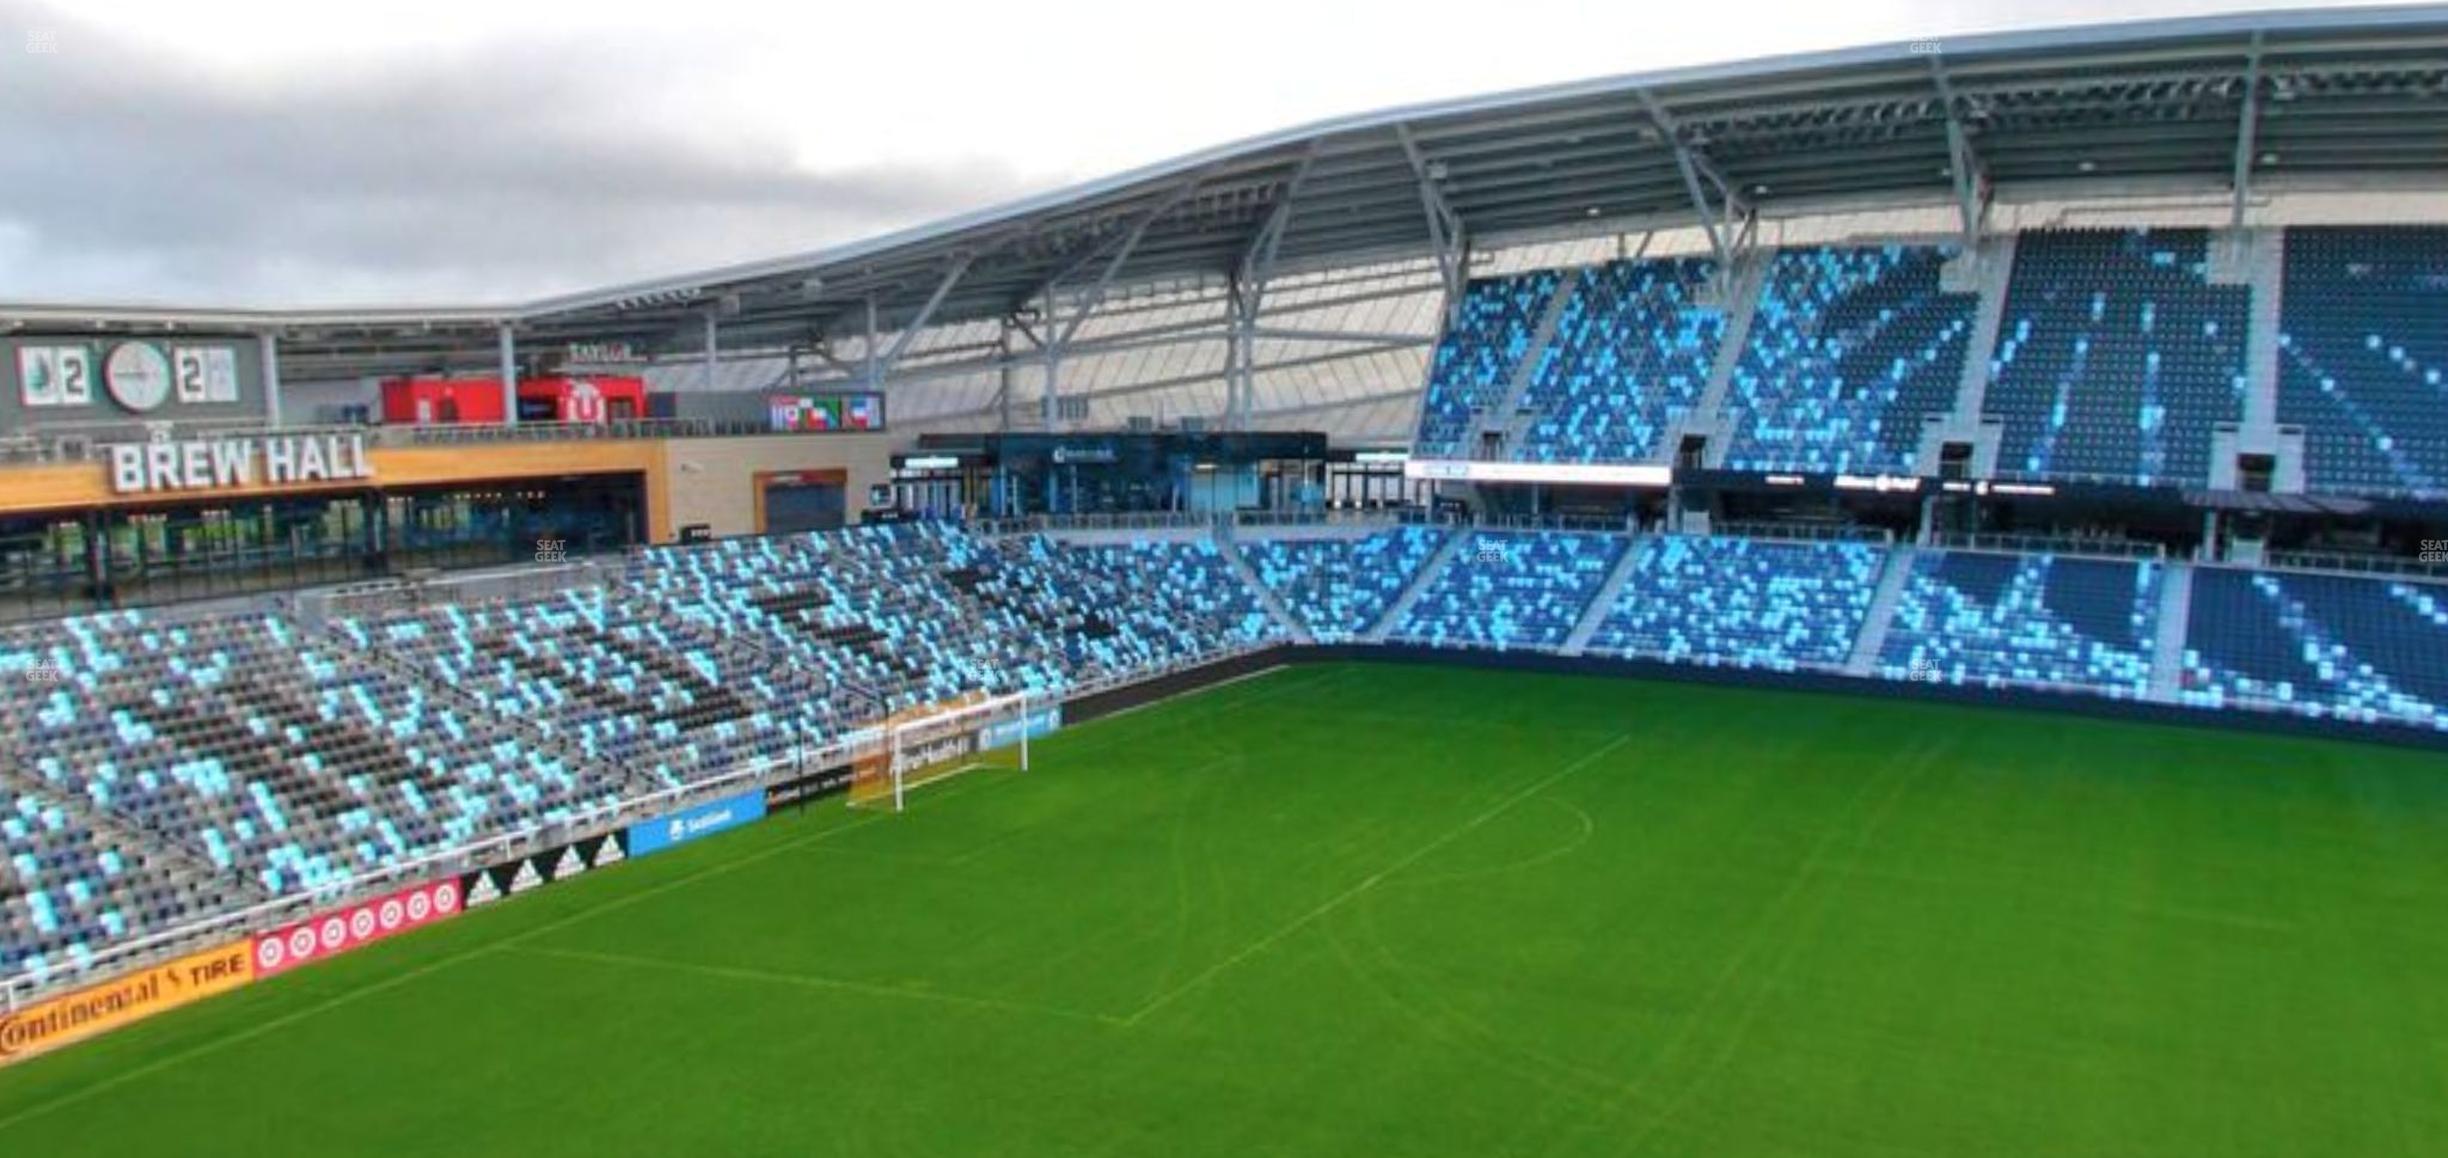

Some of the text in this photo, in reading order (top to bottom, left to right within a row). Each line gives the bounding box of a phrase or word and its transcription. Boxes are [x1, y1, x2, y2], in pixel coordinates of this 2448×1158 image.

[64, 357, 202, 394] 2 2
[114, 434, 375, 492] BREW HALL
[0, 953, 245, 1055] Continental TIRE
